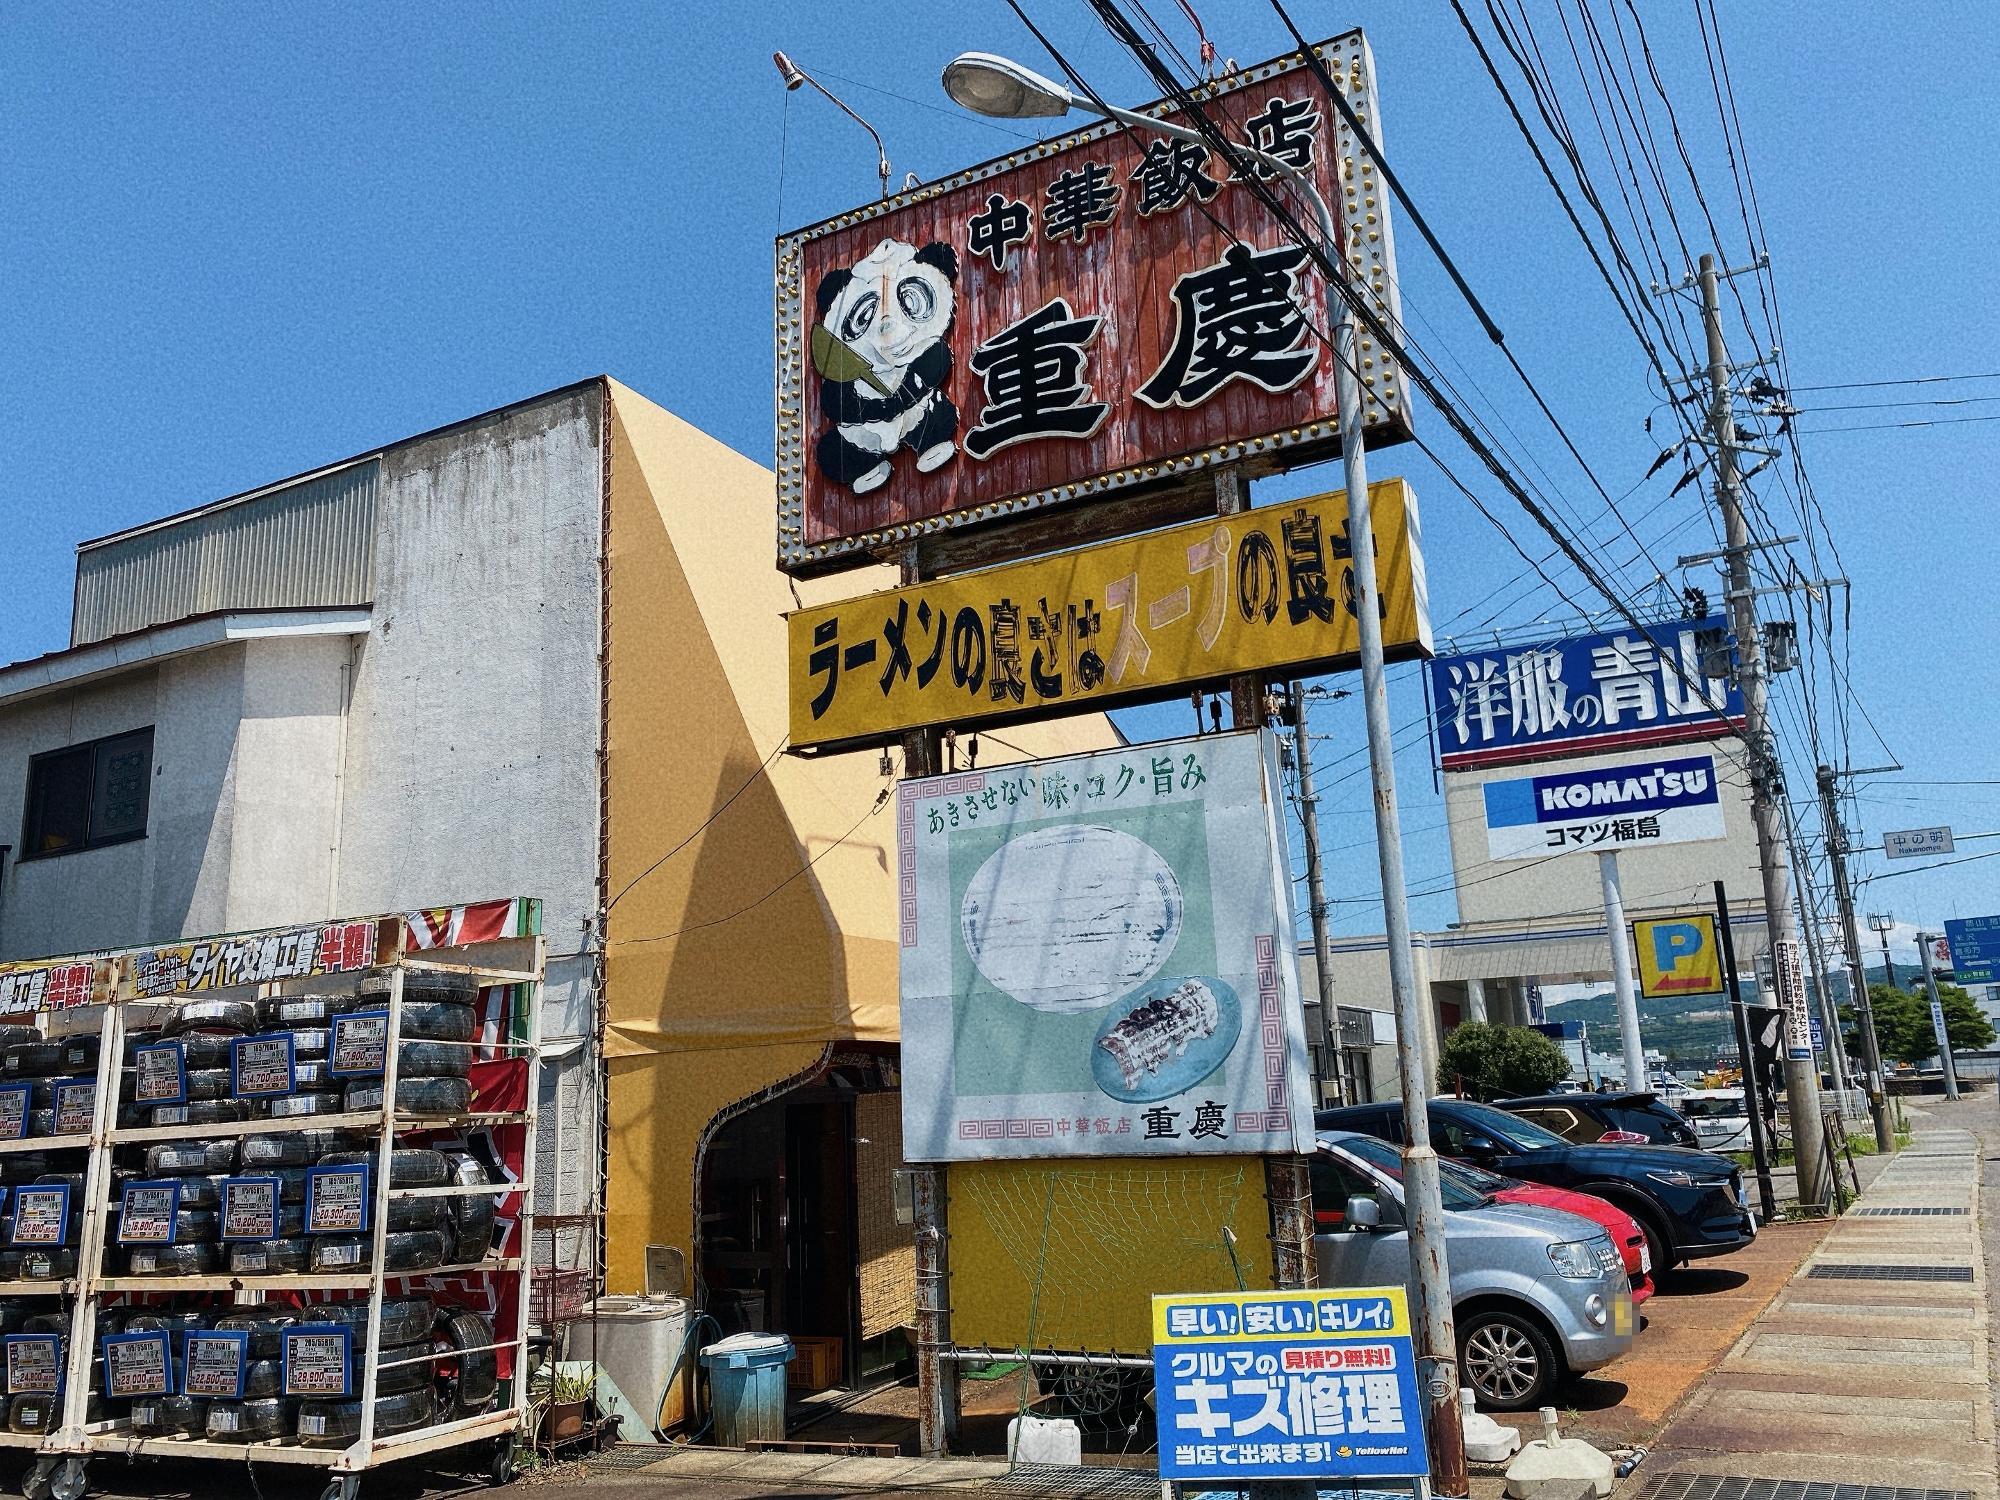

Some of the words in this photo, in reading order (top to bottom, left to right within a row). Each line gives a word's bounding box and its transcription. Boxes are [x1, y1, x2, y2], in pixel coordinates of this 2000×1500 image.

[967, 97, 1322, 272] 中華飯店
[963, 240, 1322, 461] 重慶
[1449, 630, 1727, 744] 洋服の青山
[1542, 768, 1708, 810] KOMATSU
[1546, 816, 1661, 846] コマツ福島
[189, 930, 319, 989] タイヤ交換工賃
[1652, 924, 1703, 972] P
[1056, 1109, 1131, 1136] 中華飯店
[1139, 1101, 1230, 1140] 重慶
[1171, 1308, 1237, 1336] 早い!
[1246, 1305, 1313, 1332] 安い!
[1320, 1302, 1391, 1330] キレイ!
[1171, 1351, 1279, 1378] クルマの
[1285, 1347, 1392, 1369] 見積り無料!
[1175, 1373, 1406, 1438] キズ修理
[1175, 1441, 1333, 1466] 当店で出来ます!
[1355, 1446, 1408, 1457] YellowHat
